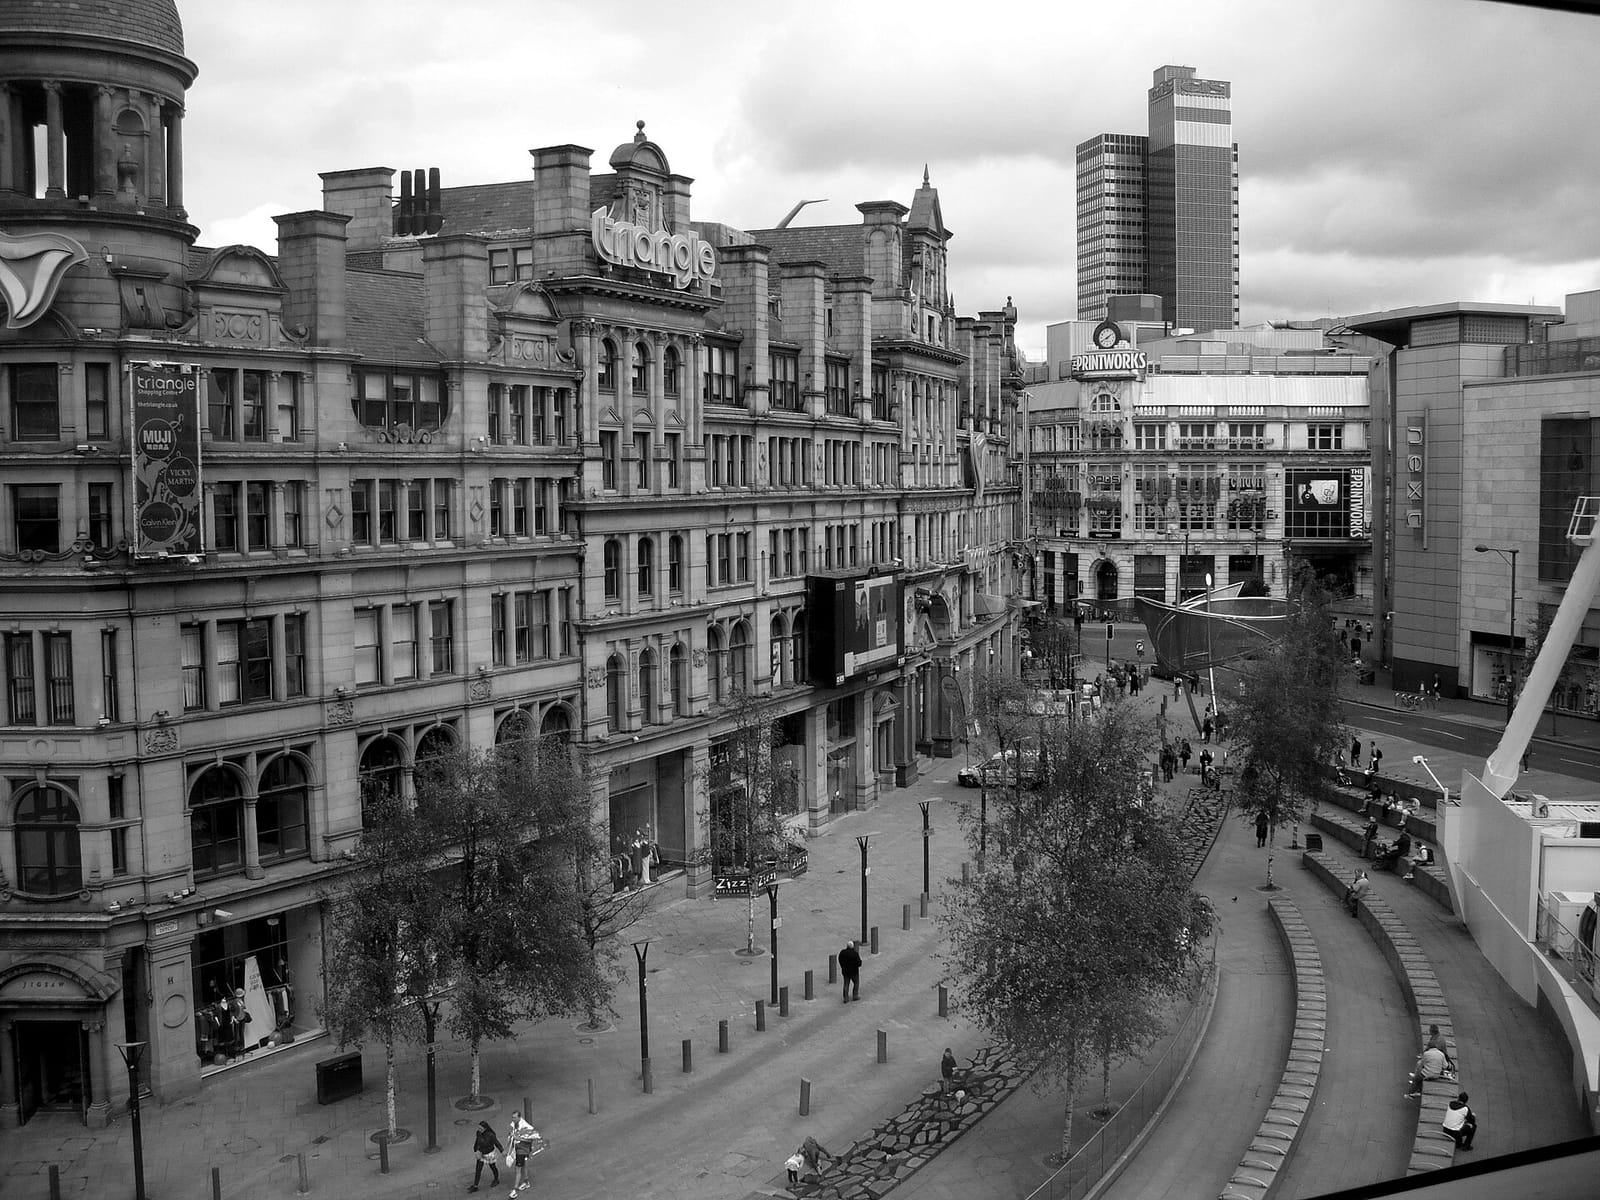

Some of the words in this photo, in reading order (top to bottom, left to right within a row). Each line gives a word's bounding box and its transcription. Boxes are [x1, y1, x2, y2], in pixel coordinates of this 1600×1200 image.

[593, 206, 715, 288] triangle
[1077, 352, 1146, 371] PRINTWORKS
[137, 375, 195, 394] triangle
[143, 430, 171, 444] MUJI
[1141, 476, 1220, 501] ODEON
[1350, 475, 1363, 538] PRINTWORKS
[141, 518, 162, 527] Calvin
[162, 518, 177, 526] Klein
